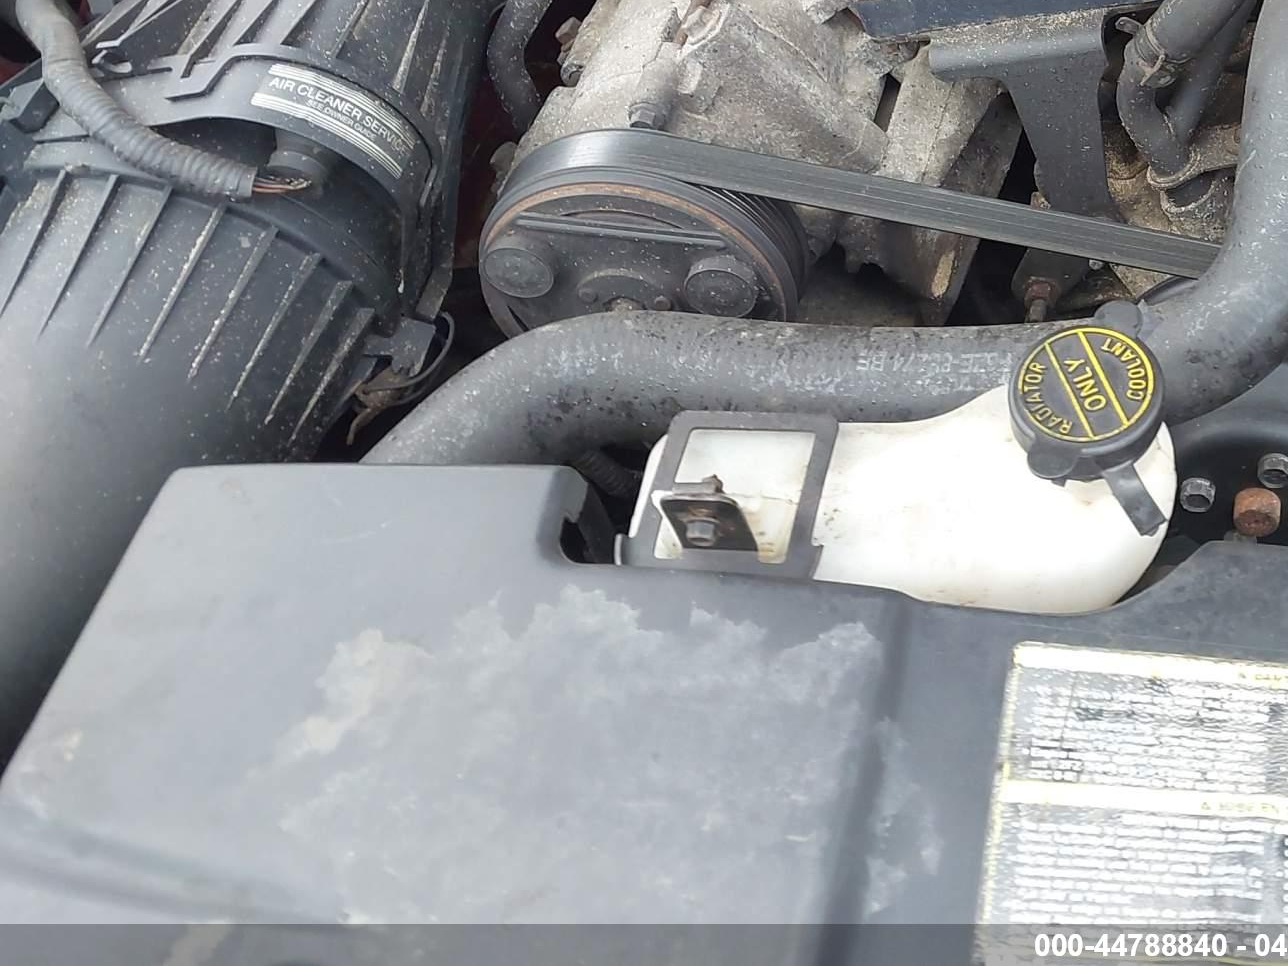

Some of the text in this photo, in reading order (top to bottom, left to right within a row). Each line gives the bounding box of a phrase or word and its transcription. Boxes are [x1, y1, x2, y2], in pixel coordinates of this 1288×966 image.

[268, 77, 412, 156] AIR CLEANER SERVICE
[305, 99, 378, 141] SEE OWNER GUIDE
[1023, 361, 1074, 434] RADIATOR
[1063, 357, 1108, 412] ONLY
[1100, 336, 1147, 402] COOLANT
